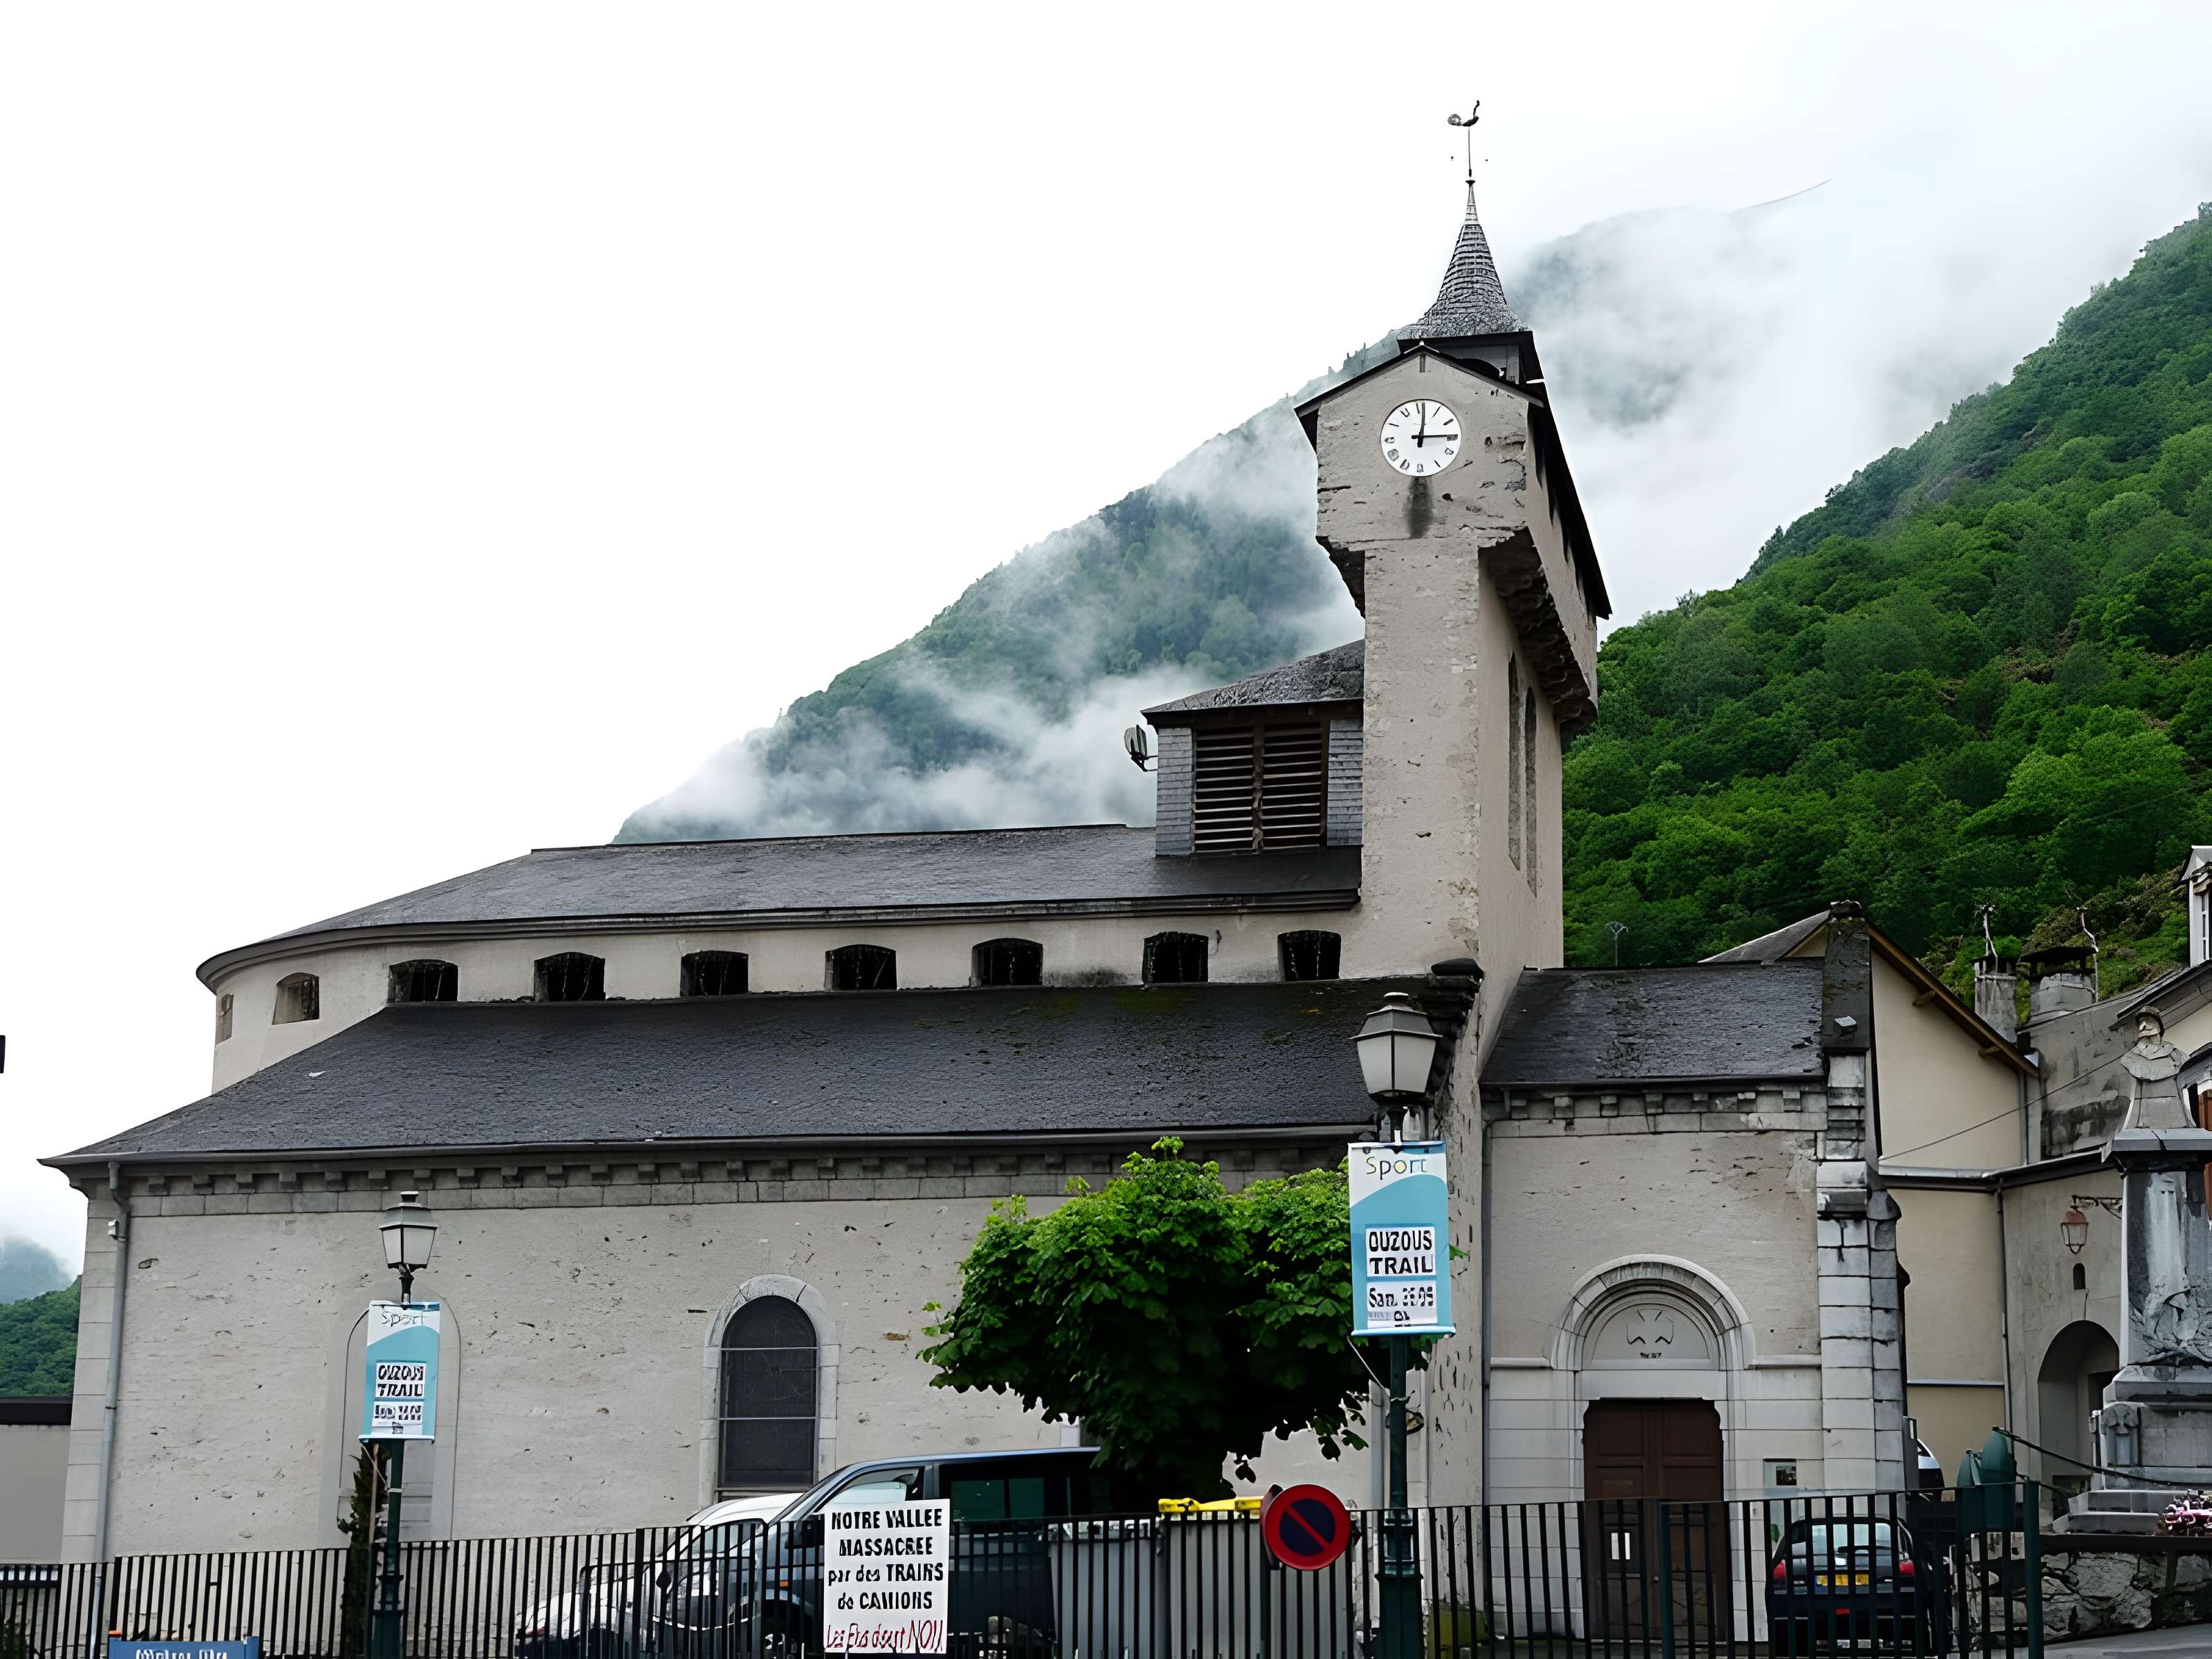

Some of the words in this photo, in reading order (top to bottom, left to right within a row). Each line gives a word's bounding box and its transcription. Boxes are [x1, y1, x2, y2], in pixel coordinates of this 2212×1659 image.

[1366, 1156, 1427, 1180] Sport
[1369, 1230, 1433, 1252] OUZOUS
[1369, 1255, 1433, 1274] TRAIL
[832, 1510, 881, 1530] NOTRE
[885, 1508, 942, 1528] VALLEE
[839, 1537, 933, 1556] MASSACREE
[828, 1570, 851, 1586] par
[856, 1564, 880, 1582] des
[886, 1563, 944, 1582] TRAINS
[838, 1592, 854, 1609] de
[860, 1591, 932, 1609] CAMIONS
